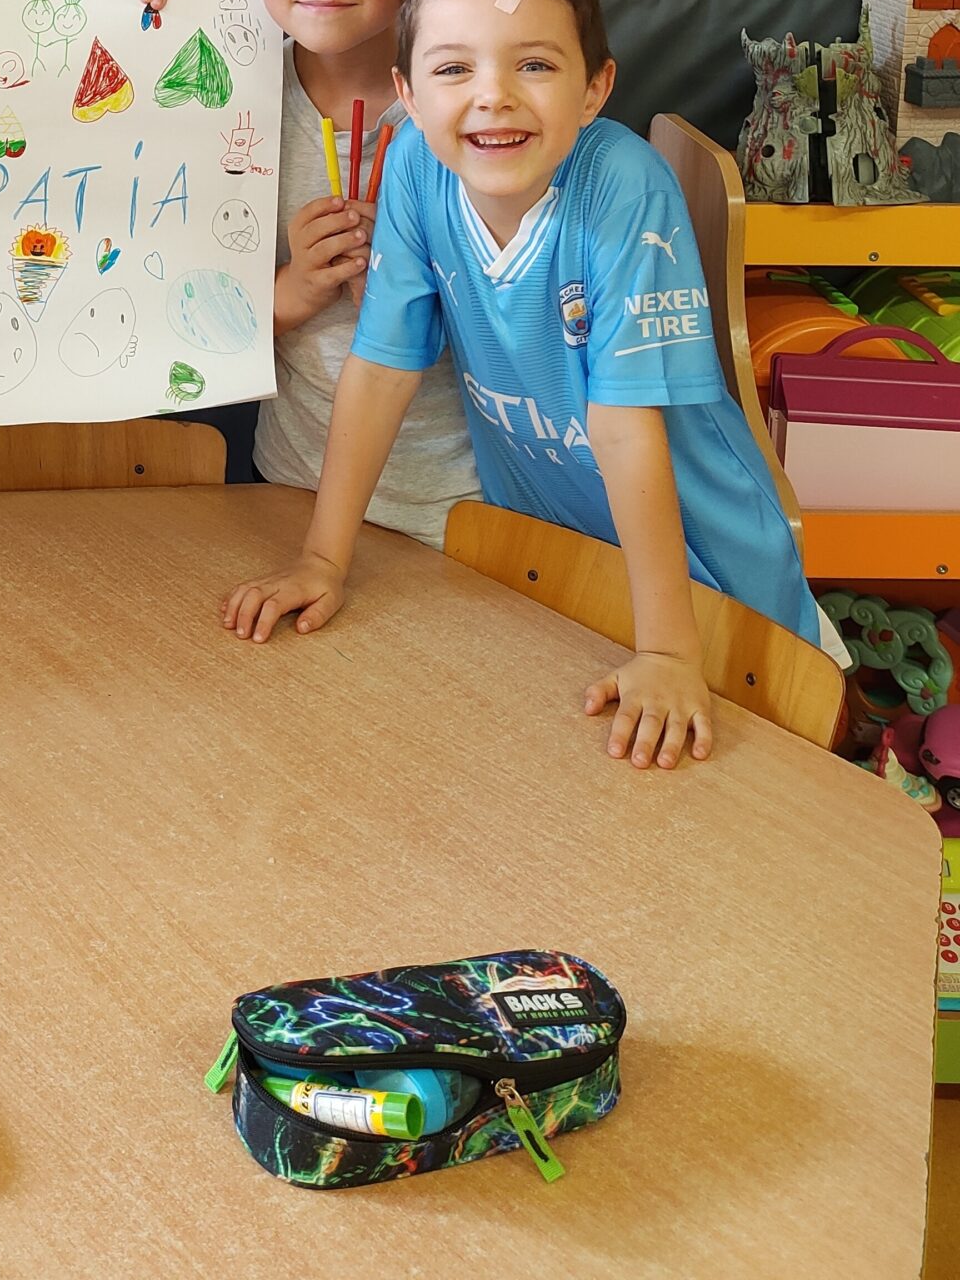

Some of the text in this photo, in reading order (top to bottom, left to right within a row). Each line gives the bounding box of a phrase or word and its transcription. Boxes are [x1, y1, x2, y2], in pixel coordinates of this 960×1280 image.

[624, 287, 708, 316] NEXEN
[637, 314, 700, 338] TIRE
[504, 994, 565, 1012] BACK
